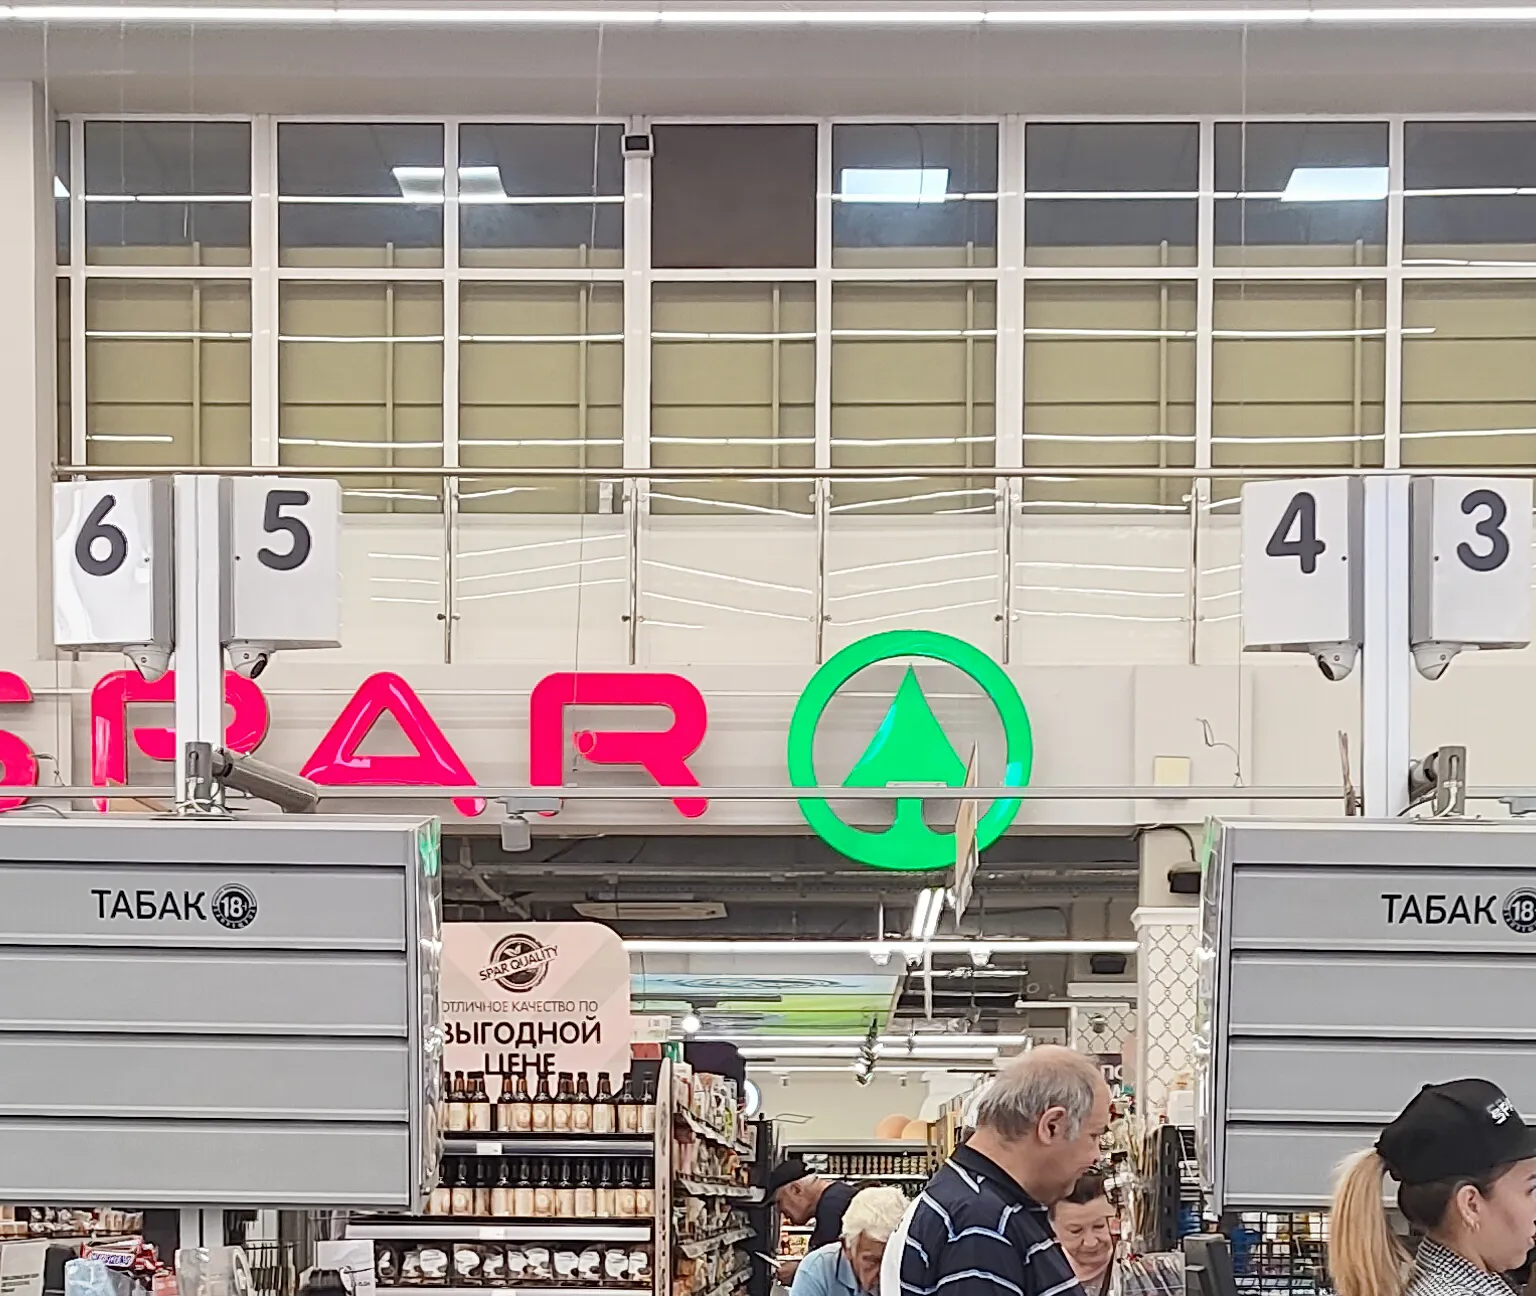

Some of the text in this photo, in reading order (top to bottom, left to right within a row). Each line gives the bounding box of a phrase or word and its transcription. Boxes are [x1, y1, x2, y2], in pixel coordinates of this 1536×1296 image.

[74, 494, 129, 577] 6
[257, 490, 311, 571] 5
[1265, 492, 1326, 574] 4
[1456, 489, 1510, 572] 3
[91, 889, 207, 920] ТАБАК
[1381, 894, 1497, 924] ТАБАК
[479, 945, 559, 981] SPAR QUALITY
[442, 1000, 598, 1013] ОТЛИЧНОЕ КАЧЕСТВО ПО
[444, 1015, 602, 1048] ВЫГОДНОЙ
[484, 1053, 556, 1077] ЦЕНЕ
